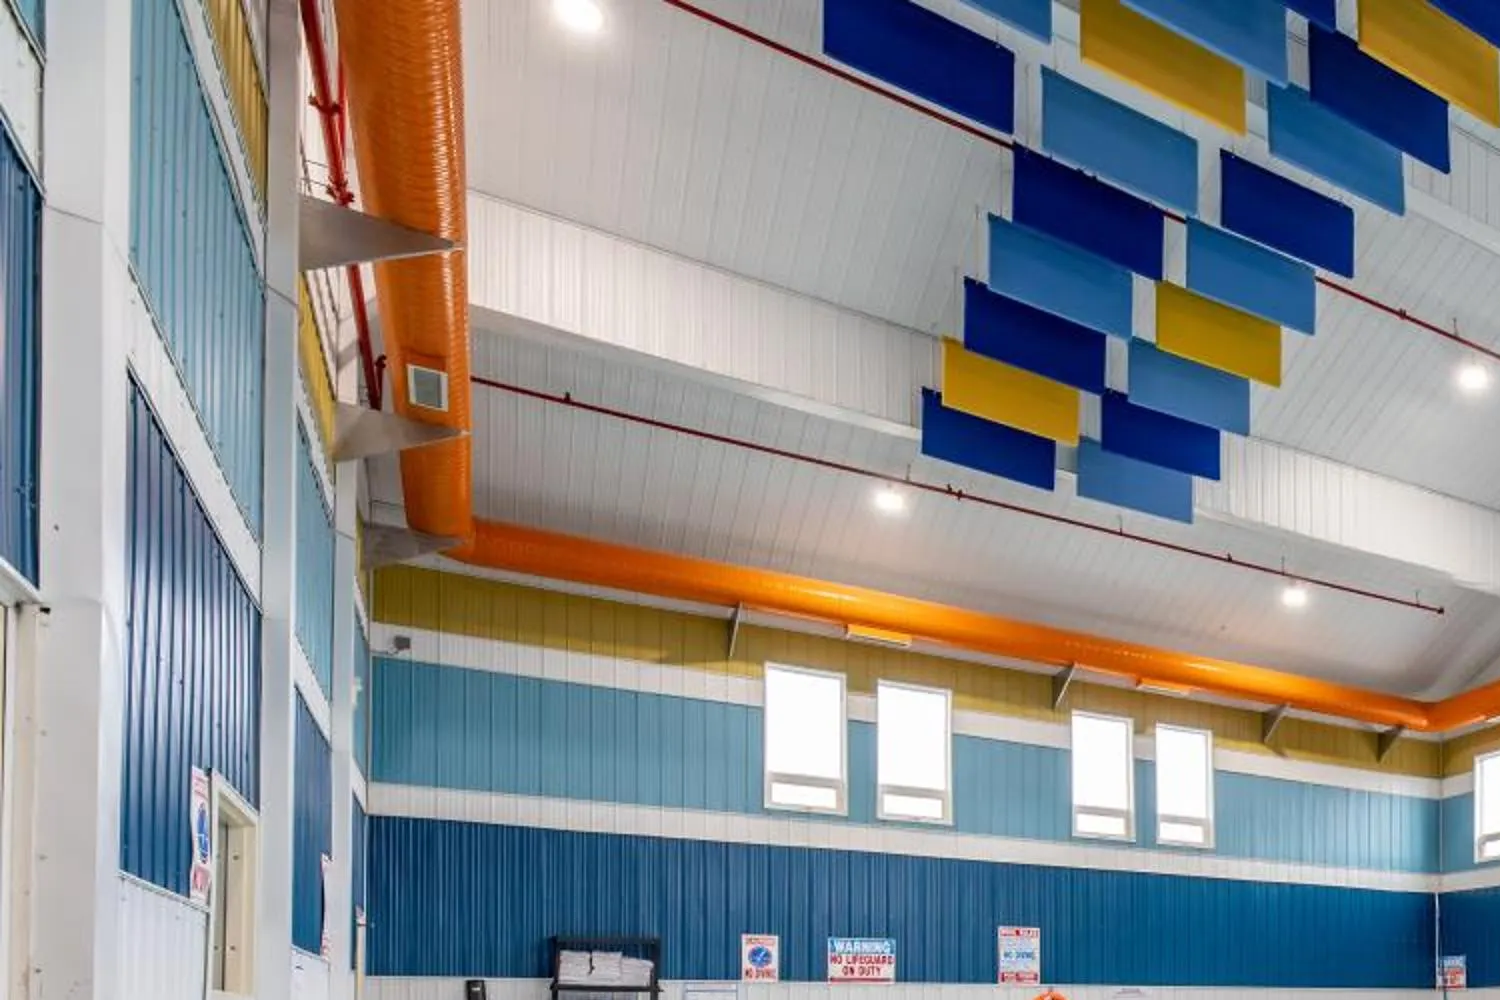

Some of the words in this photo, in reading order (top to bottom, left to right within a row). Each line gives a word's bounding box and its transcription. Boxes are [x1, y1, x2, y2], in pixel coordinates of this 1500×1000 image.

[834, 940, 891, 954] WARNING
[830, 955, 844, 965] NO
[846, 955, 894, 965] LIFEGUARD
[841, 966, 854, 977] ON
[858, 966, 882, 977] DUTY
